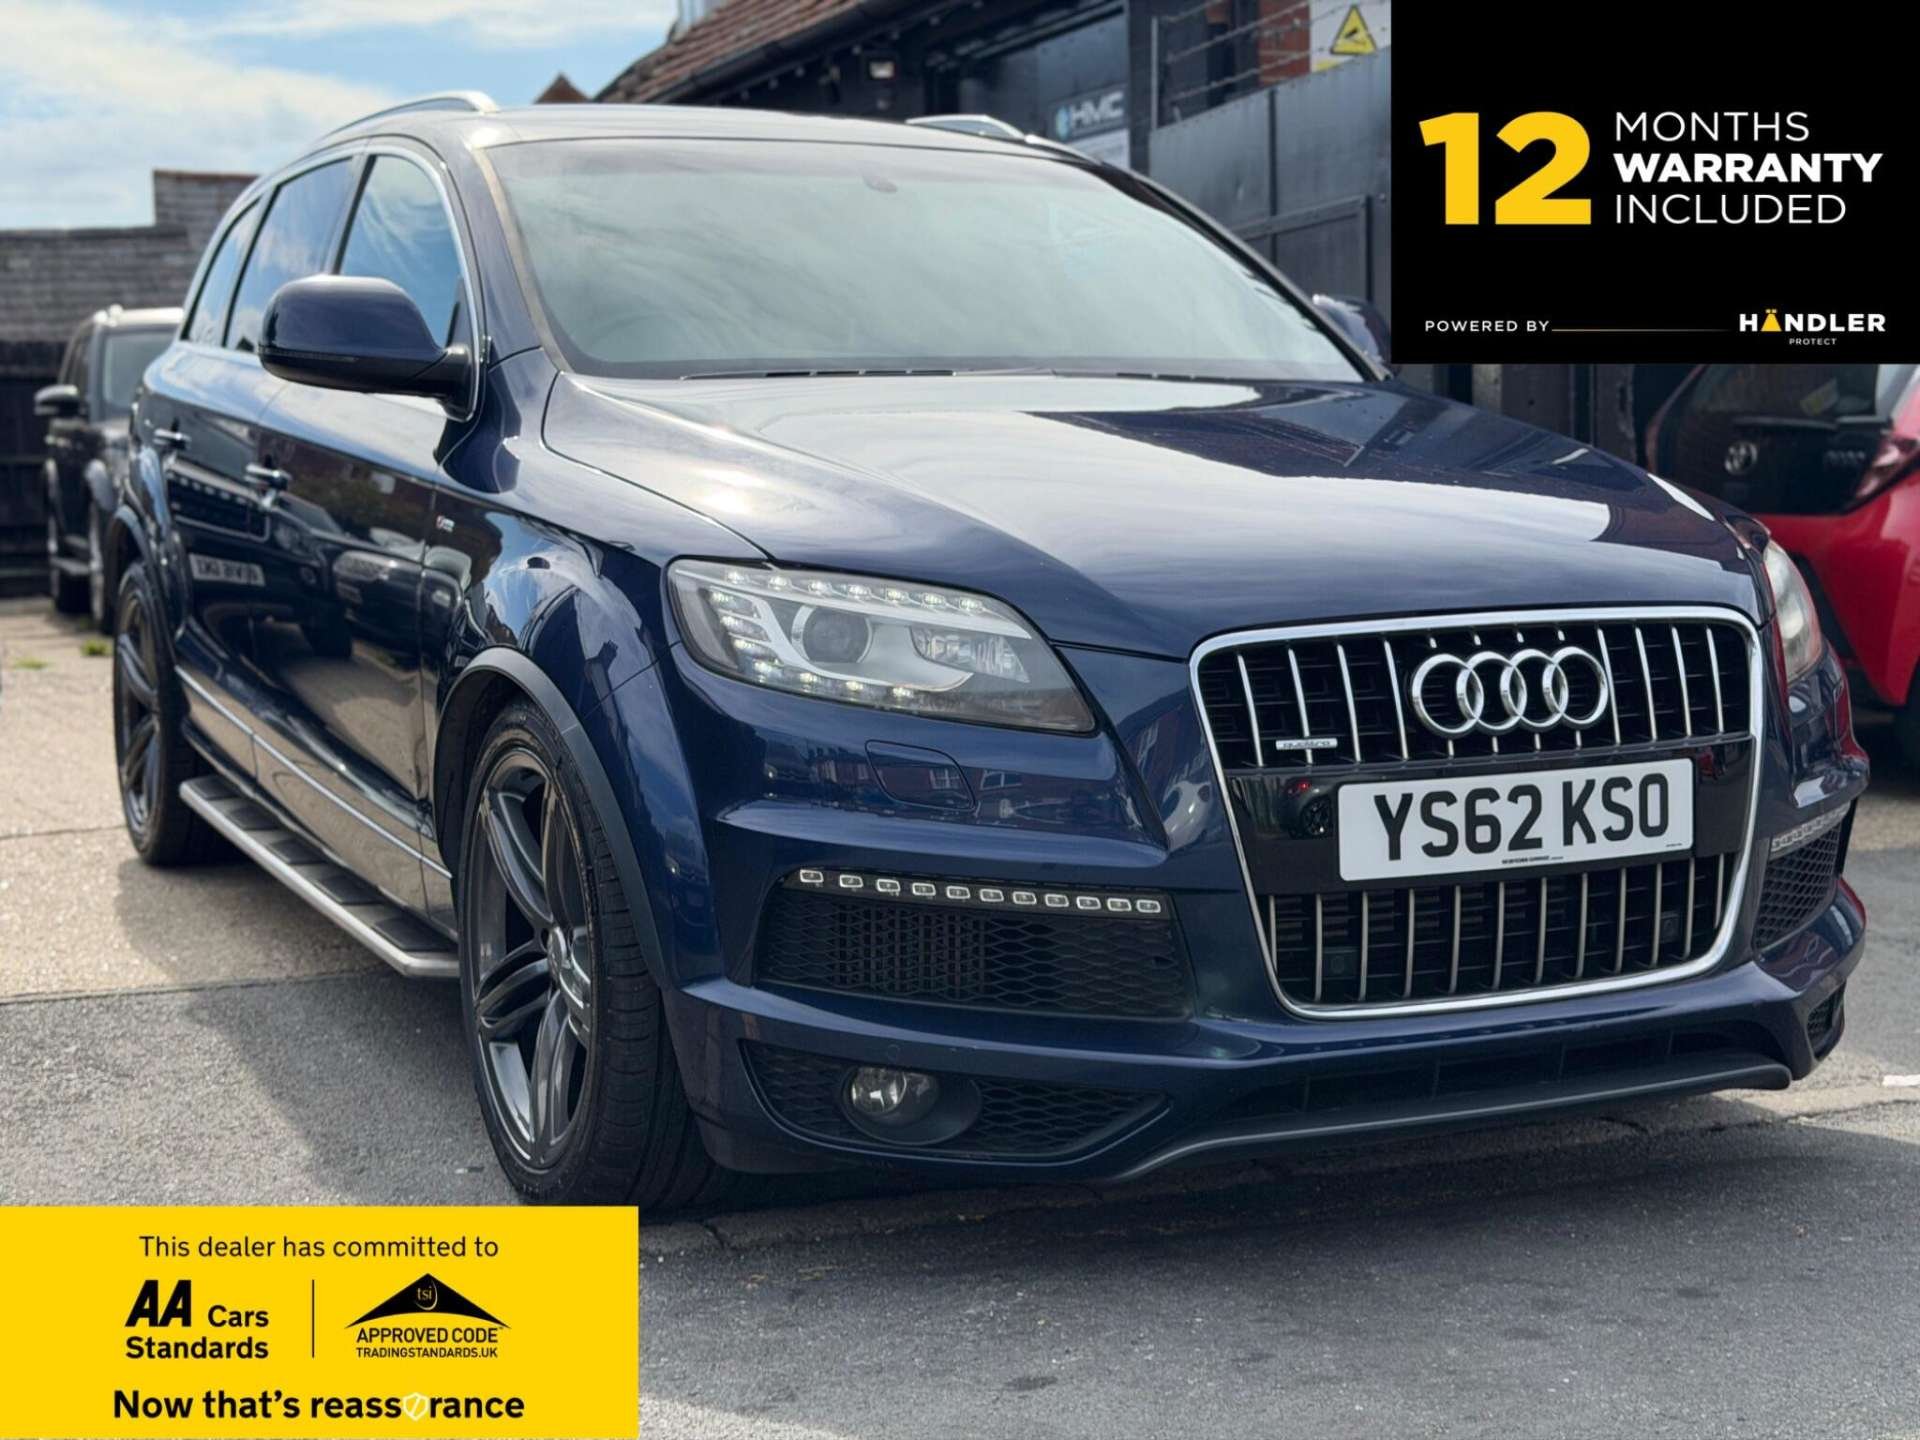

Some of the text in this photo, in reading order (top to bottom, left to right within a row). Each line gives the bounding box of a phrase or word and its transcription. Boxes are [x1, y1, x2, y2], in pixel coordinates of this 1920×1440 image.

[1070, 91, 1124, 128] HMC
[1373, 772, 1670, 862] YS62 KSO
